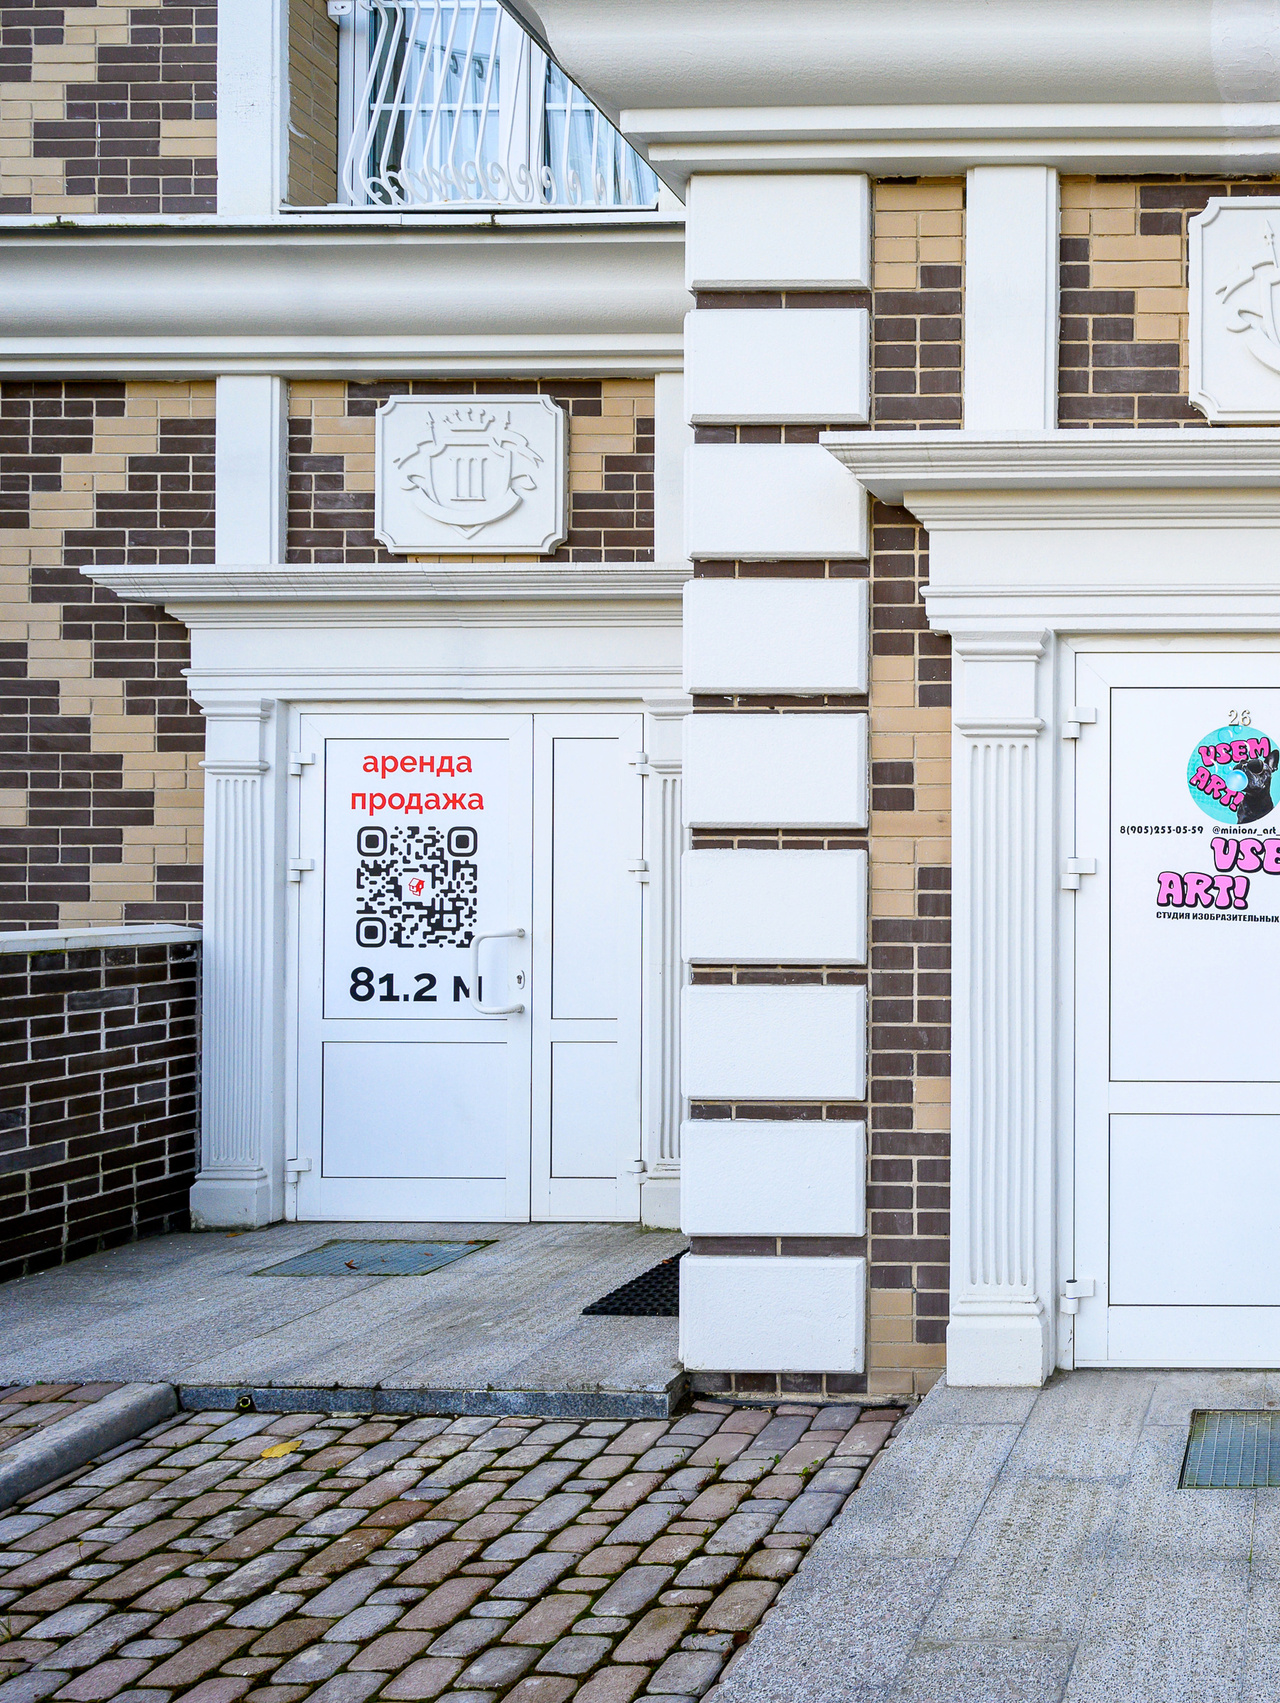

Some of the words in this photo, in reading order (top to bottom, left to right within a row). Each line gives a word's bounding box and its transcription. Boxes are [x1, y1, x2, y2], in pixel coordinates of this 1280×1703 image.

[1228, 709, 1252, 727] 26
[362, 755, 473, 779] аренда
[1189, 766, 1245, 813] ART!
[351, 792, 485, 816] продажа
[1119, 825, 1204, 835] 8(905)253-05-59
[1156, 871, 1251, 911] ART!
[1156, 911, 1191, 921] СТУДИЯ
[1192, 912, 1280, 924] ИЗОБРАЗИТЕЛЬНЫХ
[349, 966, 437, 1002] 81.2
